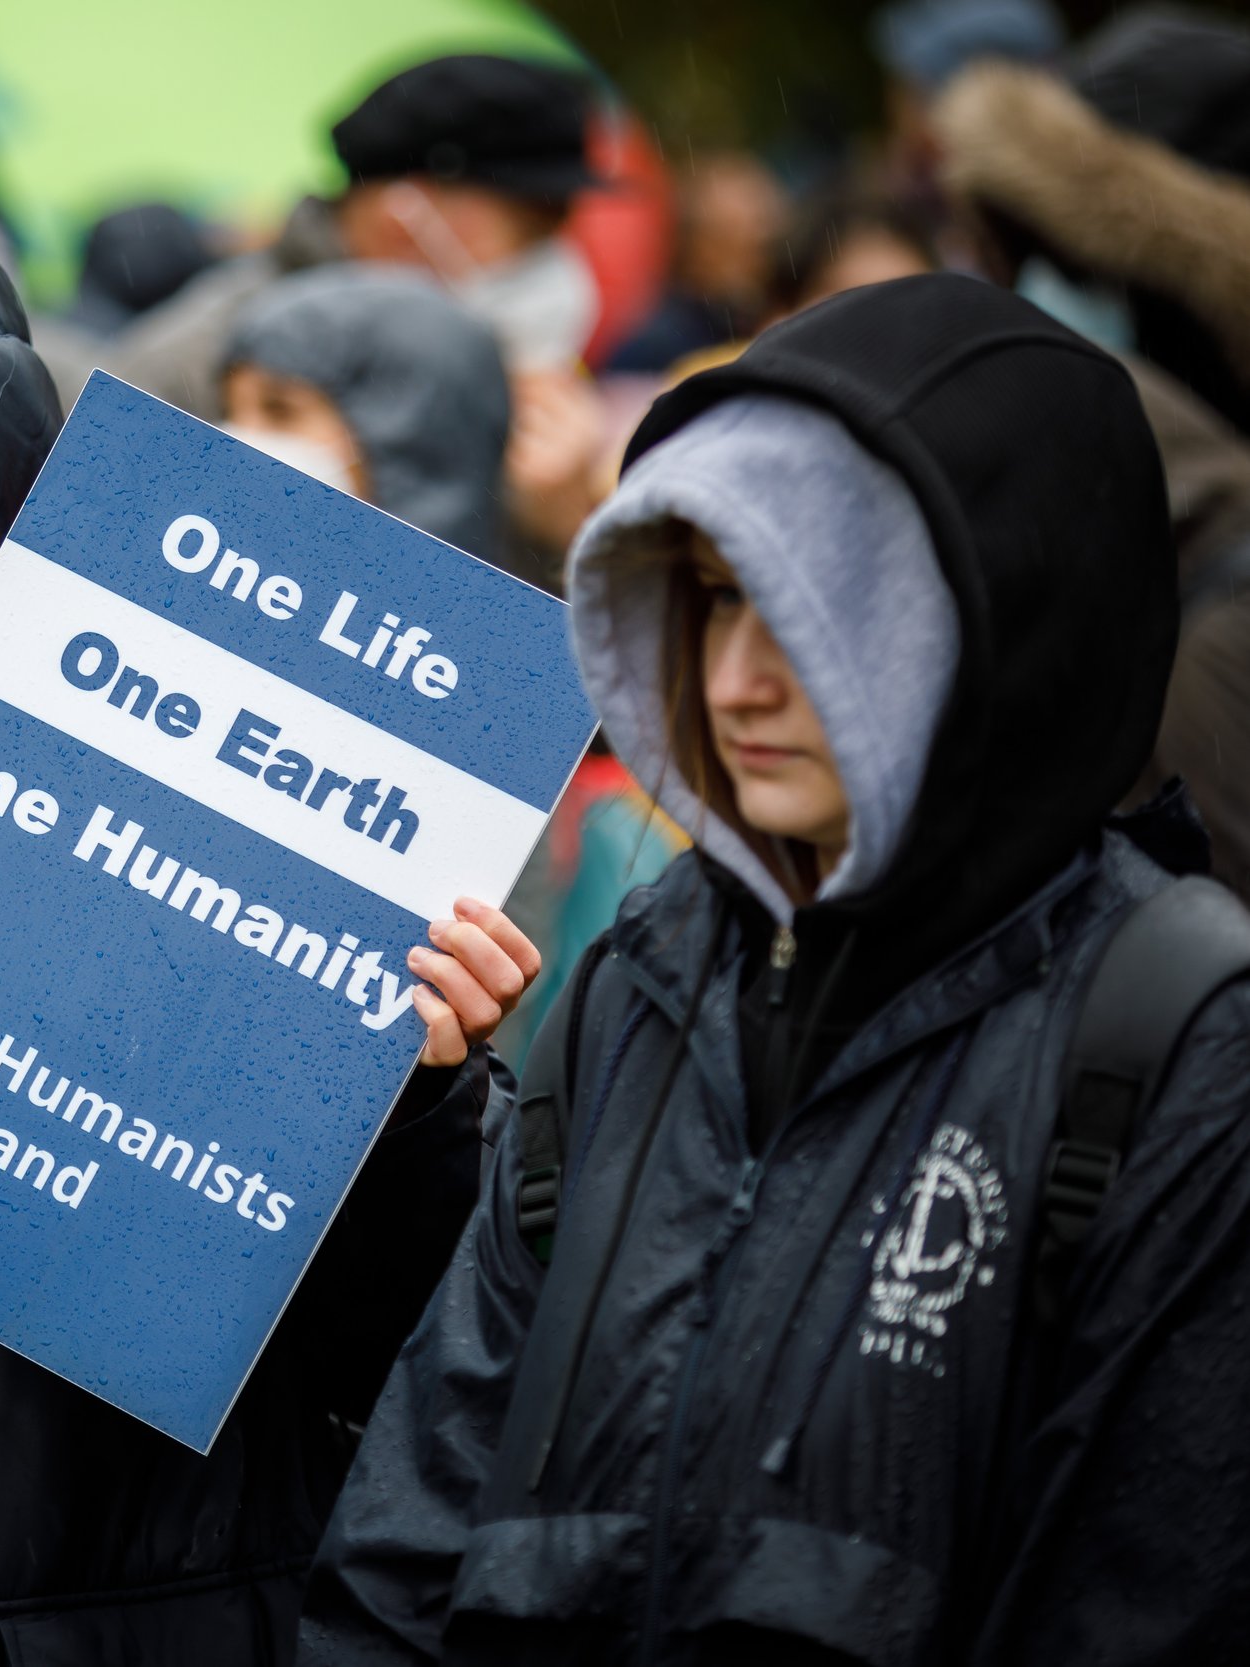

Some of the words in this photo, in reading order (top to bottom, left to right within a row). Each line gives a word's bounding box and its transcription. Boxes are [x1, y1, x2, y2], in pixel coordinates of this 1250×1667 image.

[161, 514, 303, 620] One
[318, 591, 459, 699] Life
[60, 631, 201, 738] One
[217, 710, 421, 854] Earth
[71, 804, 417, 1031] Humanity
